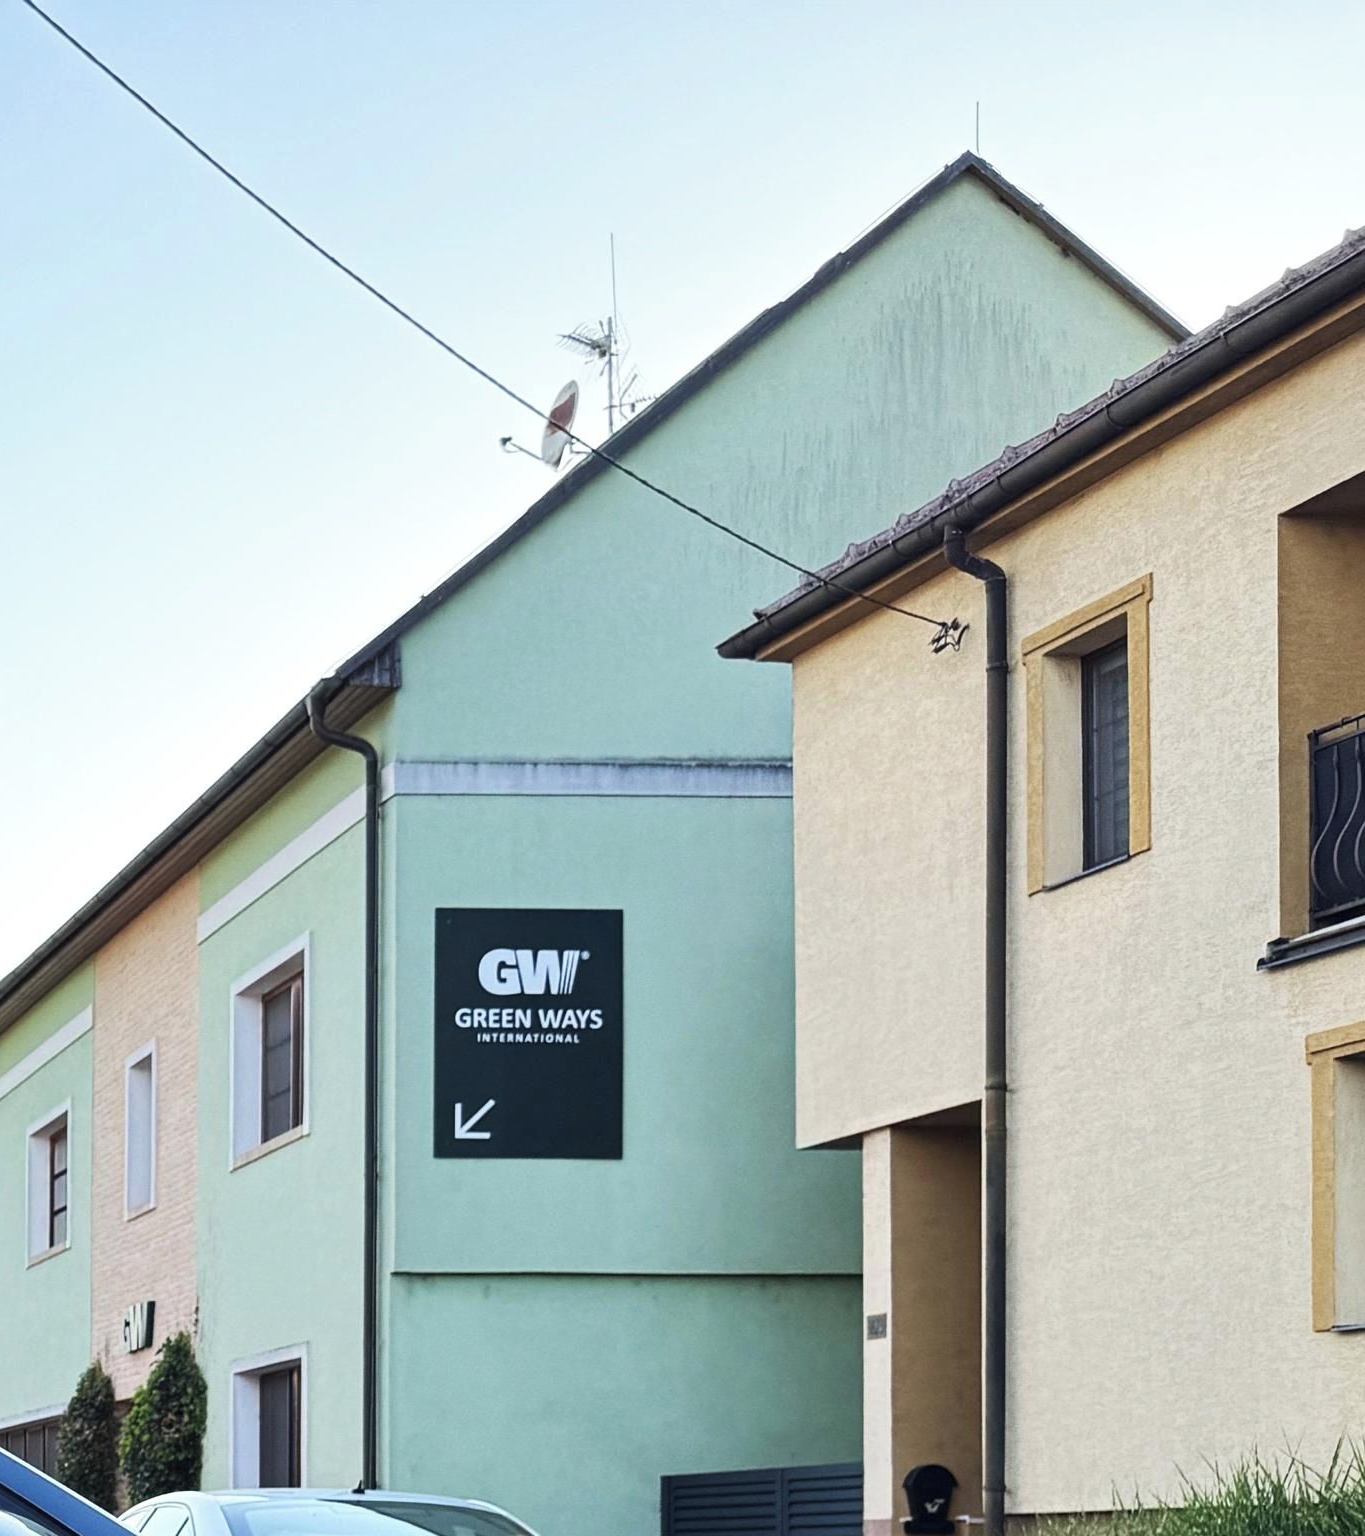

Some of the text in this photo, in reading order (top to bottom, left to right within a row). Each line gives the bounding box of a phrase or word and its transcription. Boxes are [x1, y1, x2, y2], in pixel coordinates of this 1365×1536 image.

[478, 948, 580, 996] GW
[454, 1007, 603, 1030] GREEN WAYS
[477, 1033, 580, 1044] INTERNATIONAL
